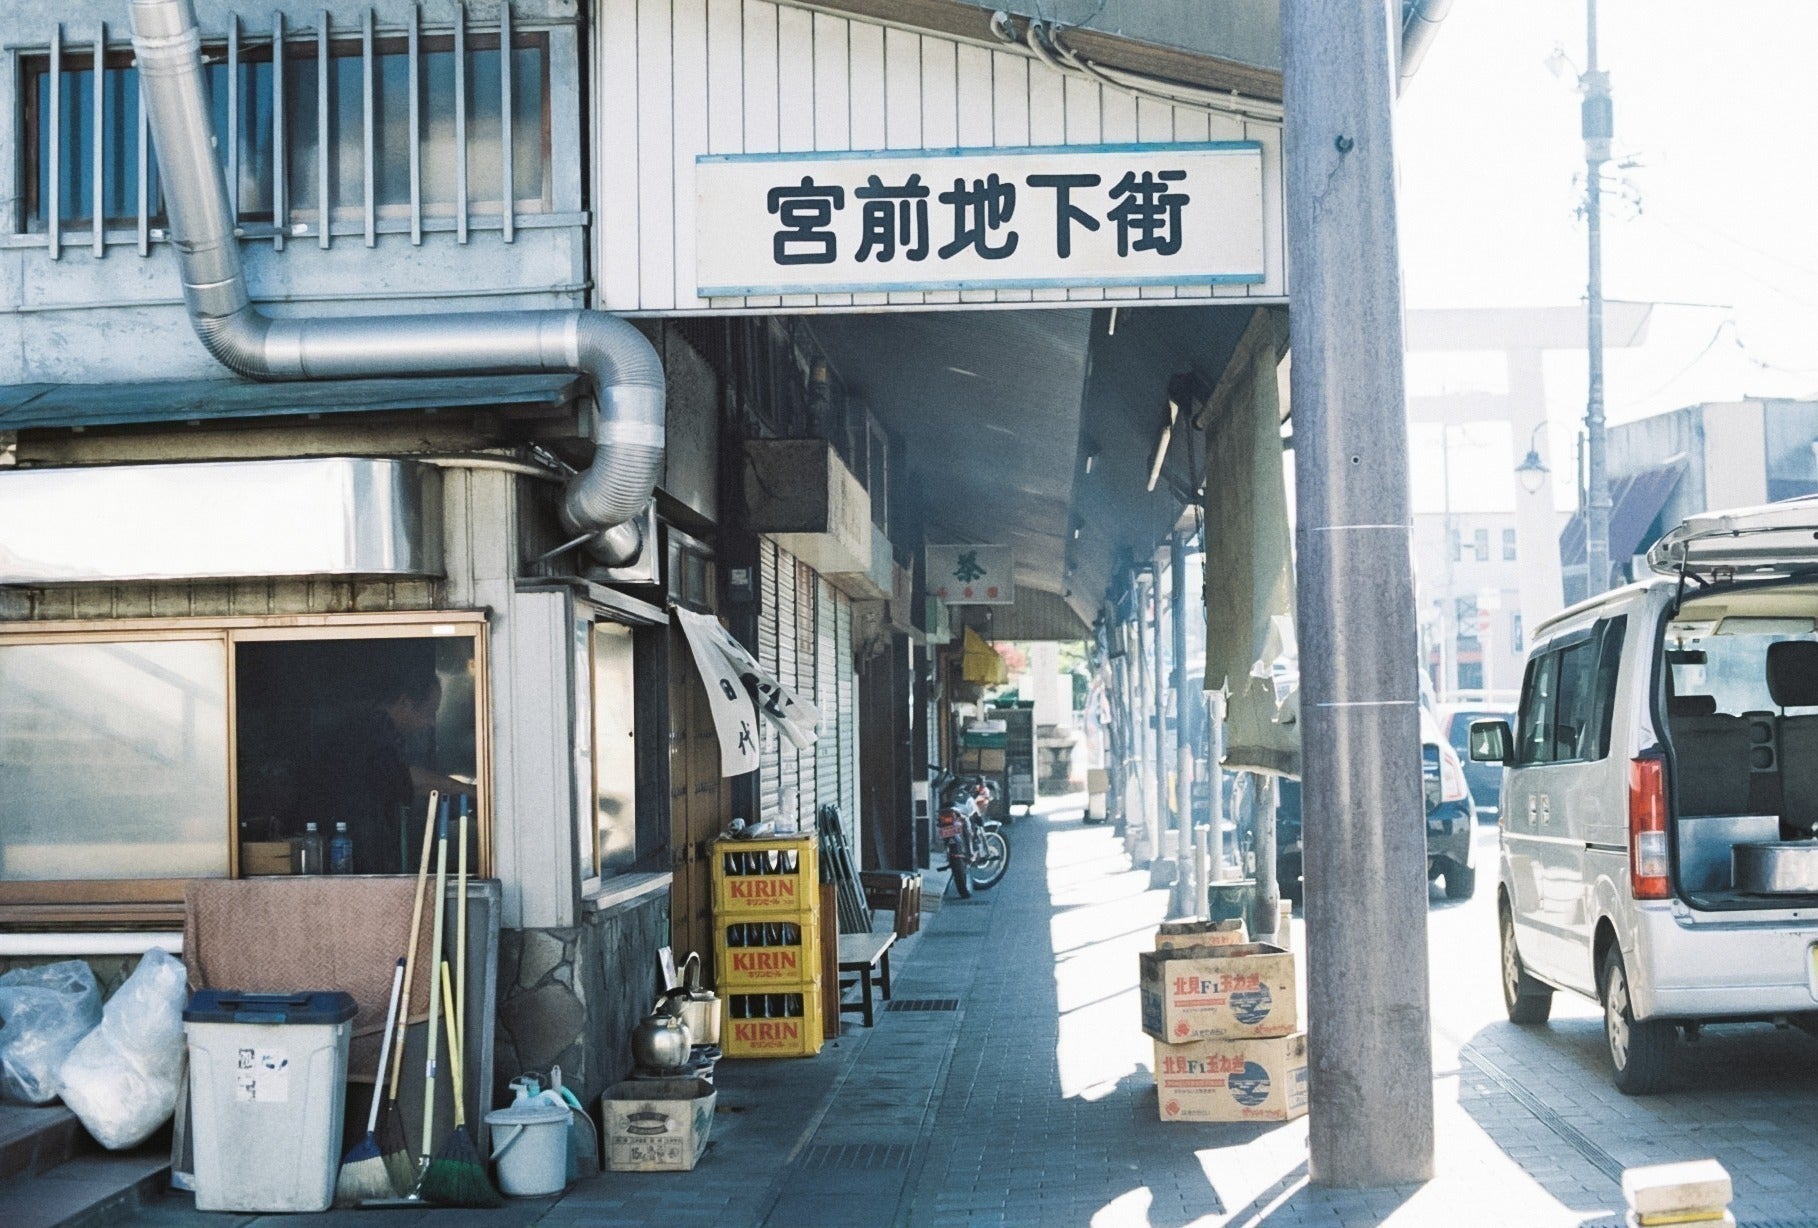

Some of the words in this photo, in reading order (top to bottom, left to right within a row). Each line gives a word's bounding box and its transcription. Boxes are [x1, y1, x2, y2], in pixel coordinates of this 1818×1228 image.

[767, 169, 1190, 266] 宮前地下街
[731, 880, 794, 898] KIRIN
[733, 951, 797, 971] KIRIN
[735, 1022, 798, 1041] KIRIN
